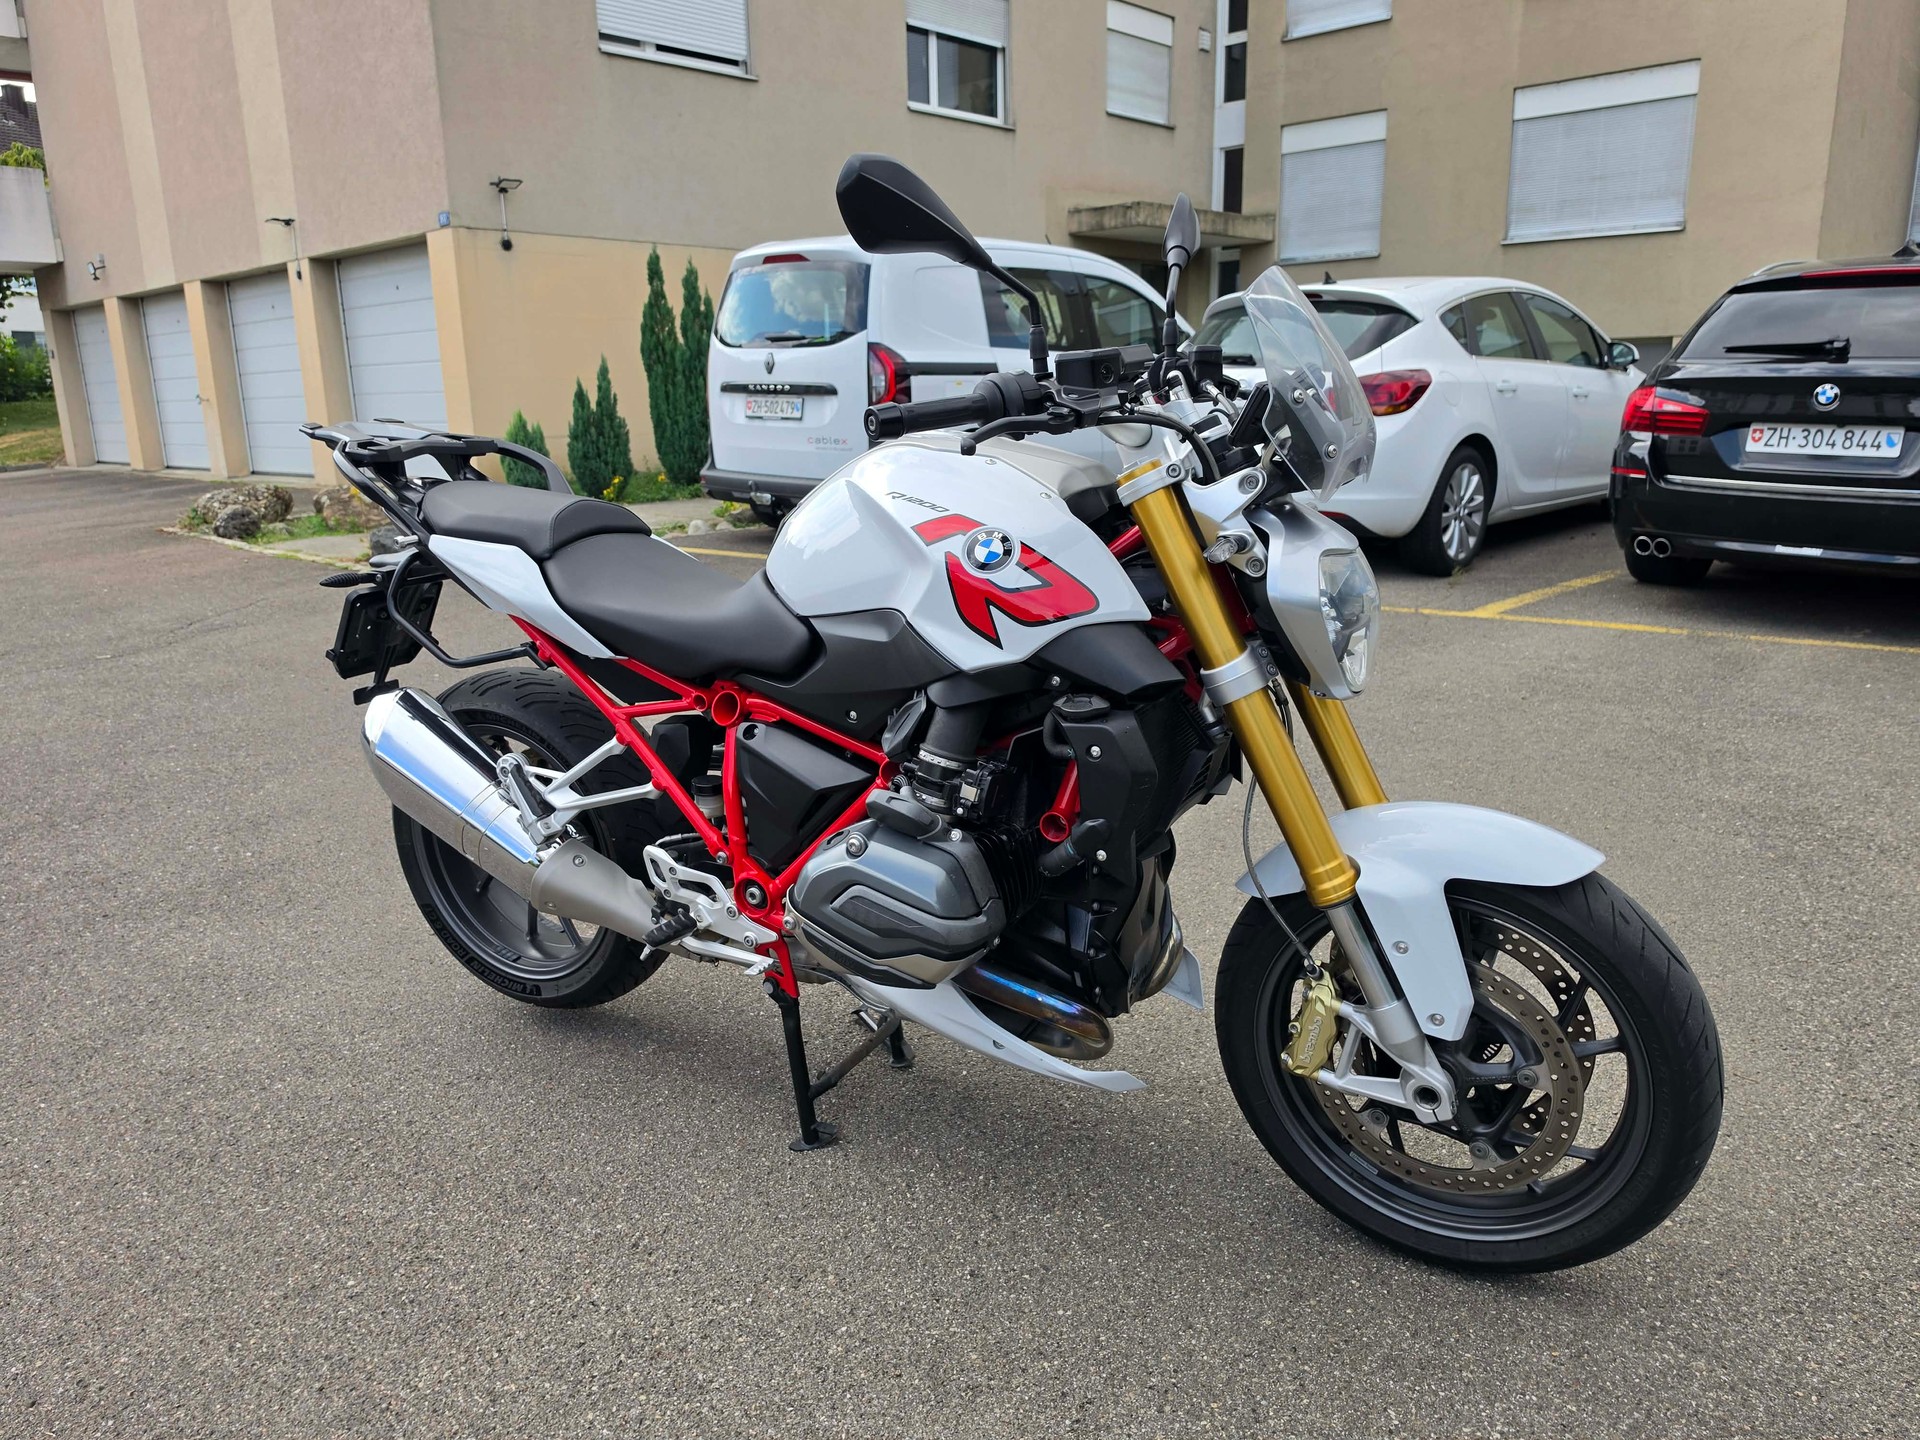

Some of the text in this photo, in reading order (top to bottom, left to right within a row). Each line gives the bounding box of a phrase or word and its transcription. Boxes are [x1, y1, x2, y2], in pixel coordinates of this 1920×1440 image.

[806, 436, 849, 445] cablex
[885, 490, 950, 513] R1200
[440, 929, 467, 959] ROAD
[470, 960, 523, 994] MICHELIN
[1299, 1016, 1323, 1064] brembo
